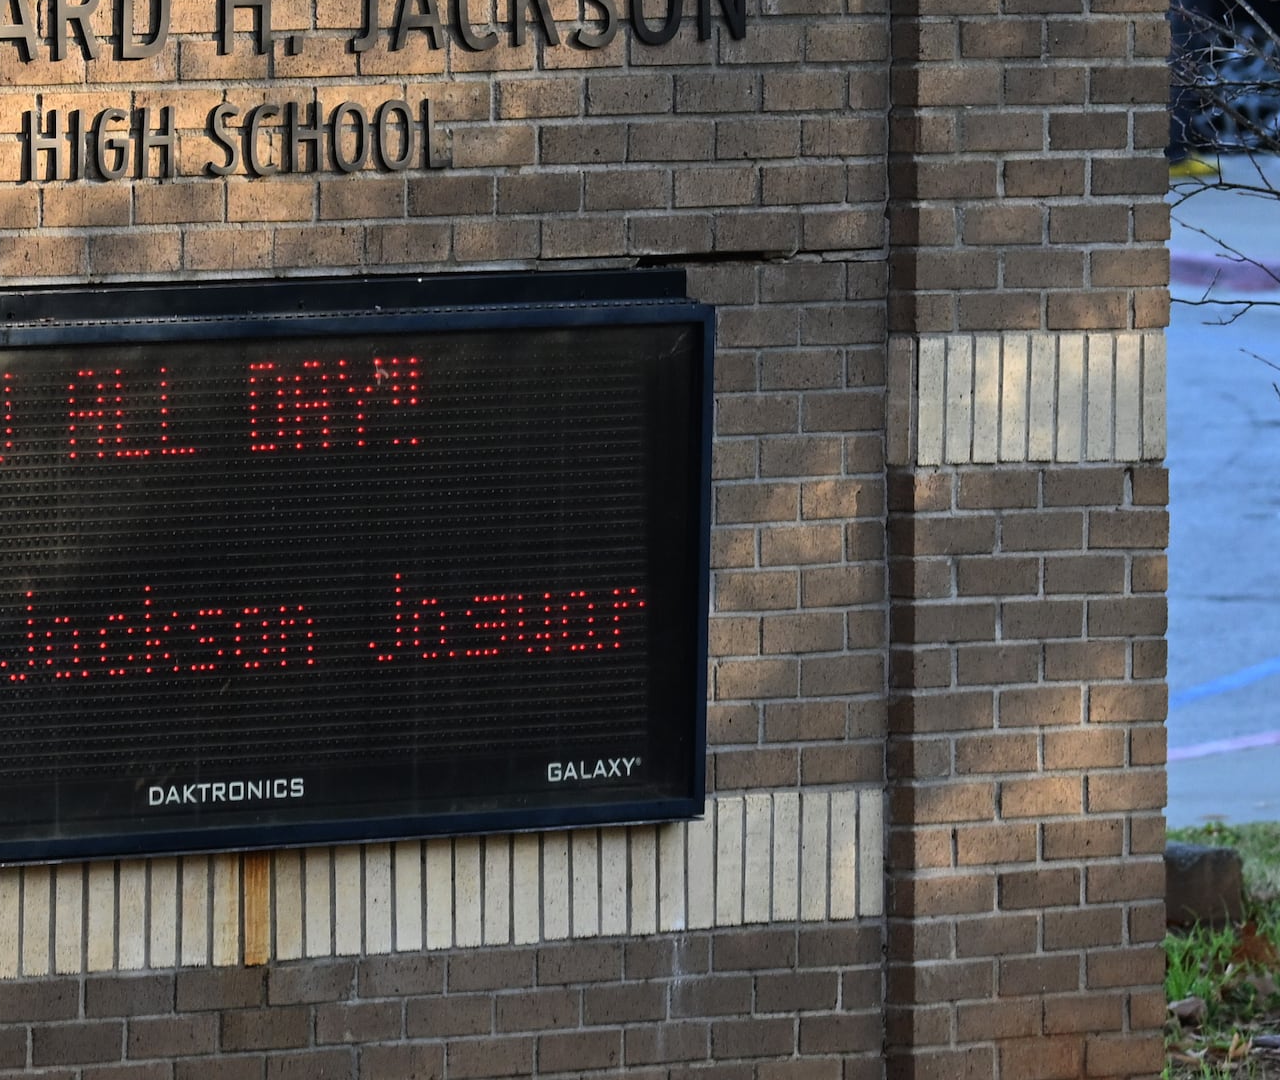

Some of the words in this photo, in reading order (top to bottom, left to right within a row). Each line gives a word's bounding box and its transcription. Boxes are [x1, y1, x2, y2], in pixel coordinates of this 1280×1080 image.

[24, 105, 175, 182] HIGH
[204, 98, 453, 177] SCHOOL
[67, 366, 196, 460] ALL
[0, 584, 315, 682] Jackson
[148, 778, 304, 806] DAKTRONICS
